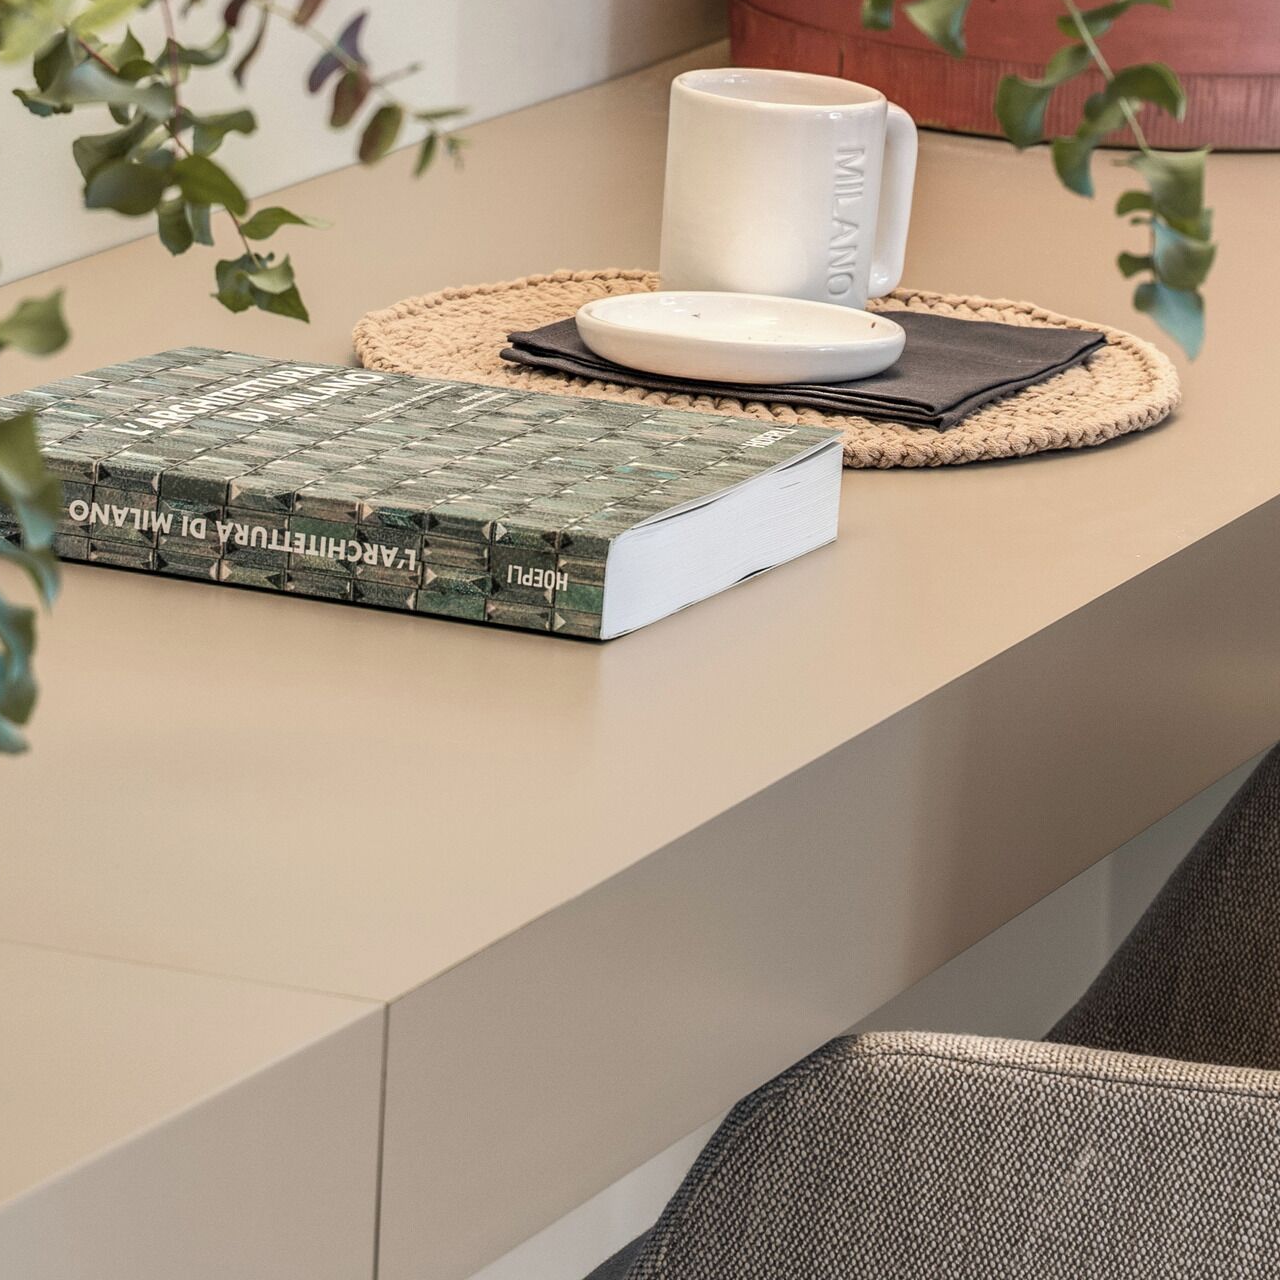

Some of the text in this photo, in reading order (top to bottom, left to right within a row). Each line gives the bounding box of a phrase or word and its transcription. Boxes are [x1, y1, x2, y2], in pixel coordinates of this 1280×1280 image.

[827, 144, 867, 297] MILANO
[111, 366, 335, 436] L'ARCHITETTURA
[226, 408, 280, 423] DI
[265, 372, 386, 412] MILANO
[69, 498, 418, 571] L'ARCHITETTURA DI MILANO
[506, 564, 569, 592] HOEPLI
